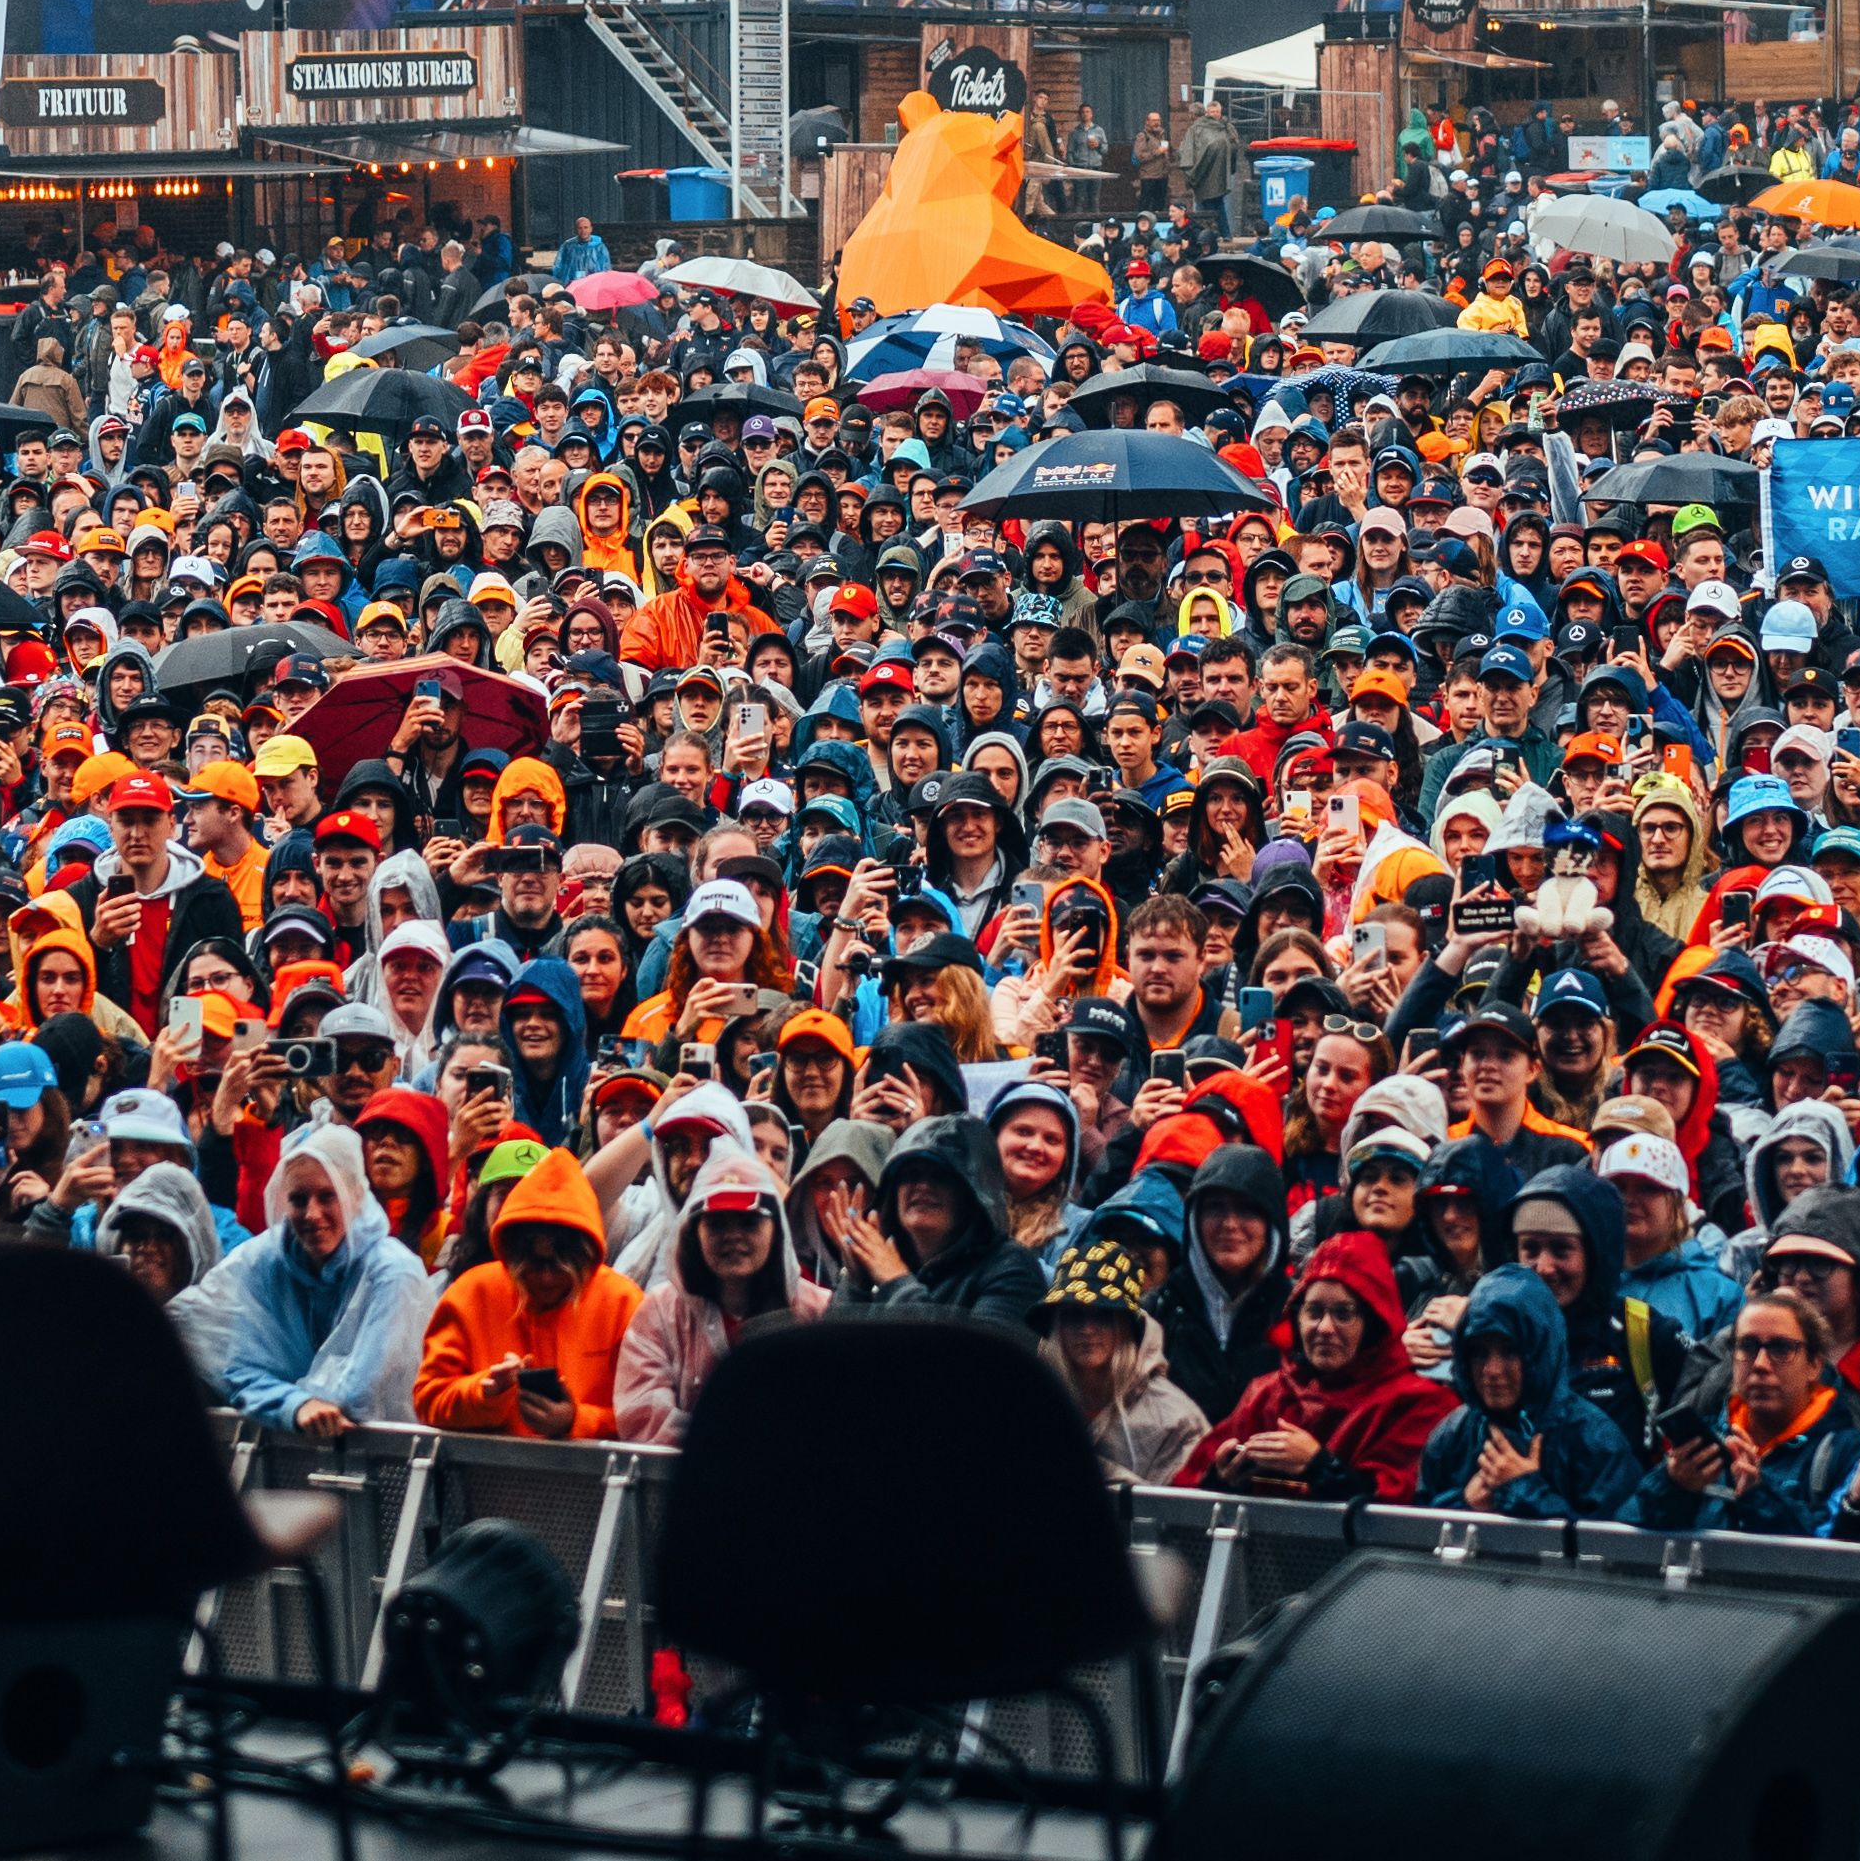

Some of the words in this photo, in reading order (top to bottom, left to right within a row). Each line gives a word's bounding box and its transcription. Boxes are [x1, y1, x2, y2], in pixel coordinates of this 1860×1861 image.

[292, 61, 403, 91] STEAKHOUSE
[406, 59, 474, 86] BURGER
[950, 64, 1006, 107] Tickets
[38, 87, 128, 117] FRITUUR
[1034, 472, 1115, 482] RACING
